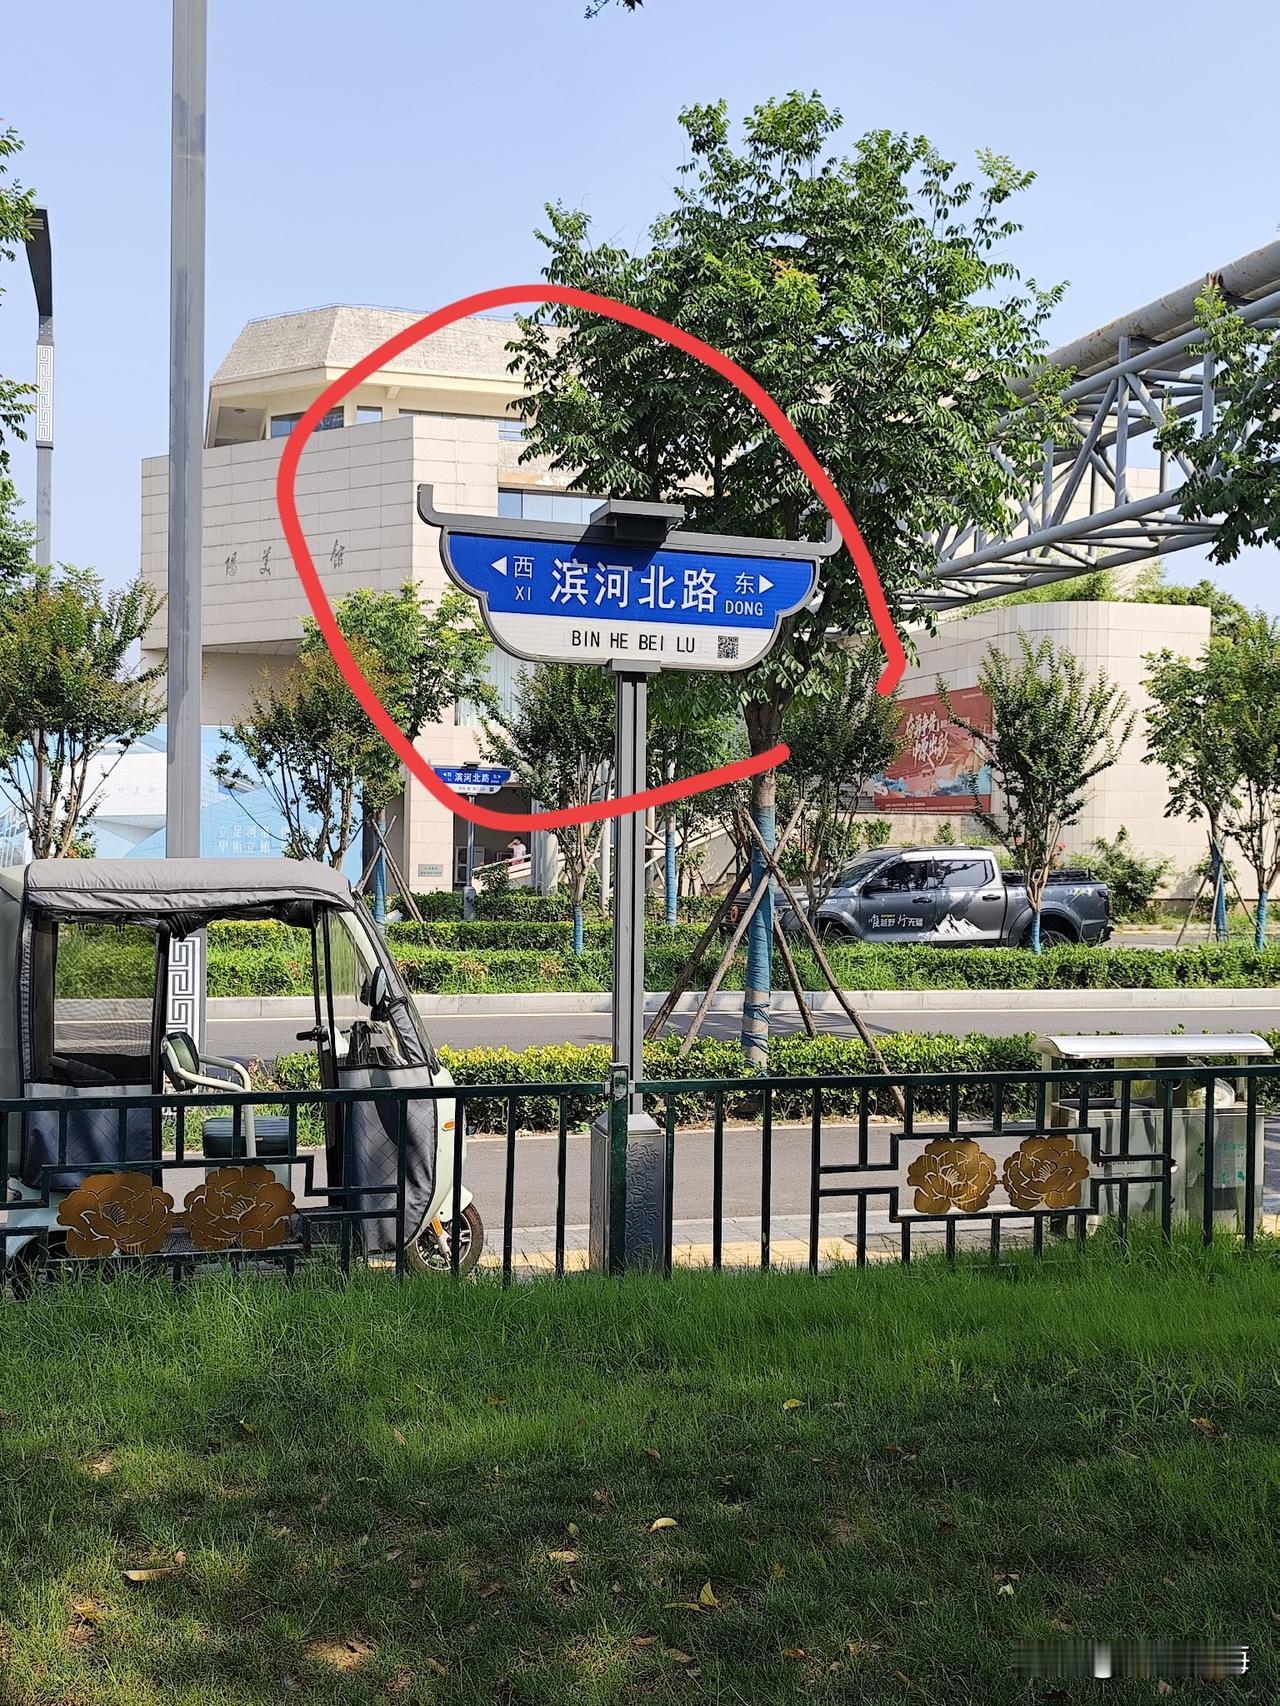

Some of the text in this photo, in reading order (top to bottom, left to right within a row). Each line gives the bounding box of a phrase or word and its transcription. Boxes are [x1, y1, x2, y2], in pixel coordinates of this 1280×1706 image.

[513, 555, 535, 579] 西
[514, 585, 532, 601] XI
[550, 557, 718, 614] 滨河北路
[734, 570, 755, 596] 东
[725, 600, 764, 617] DONG
[571, 630, 696, 654] BIN HE BEI LU
[454, 771, 490, 783] 滨河北路
